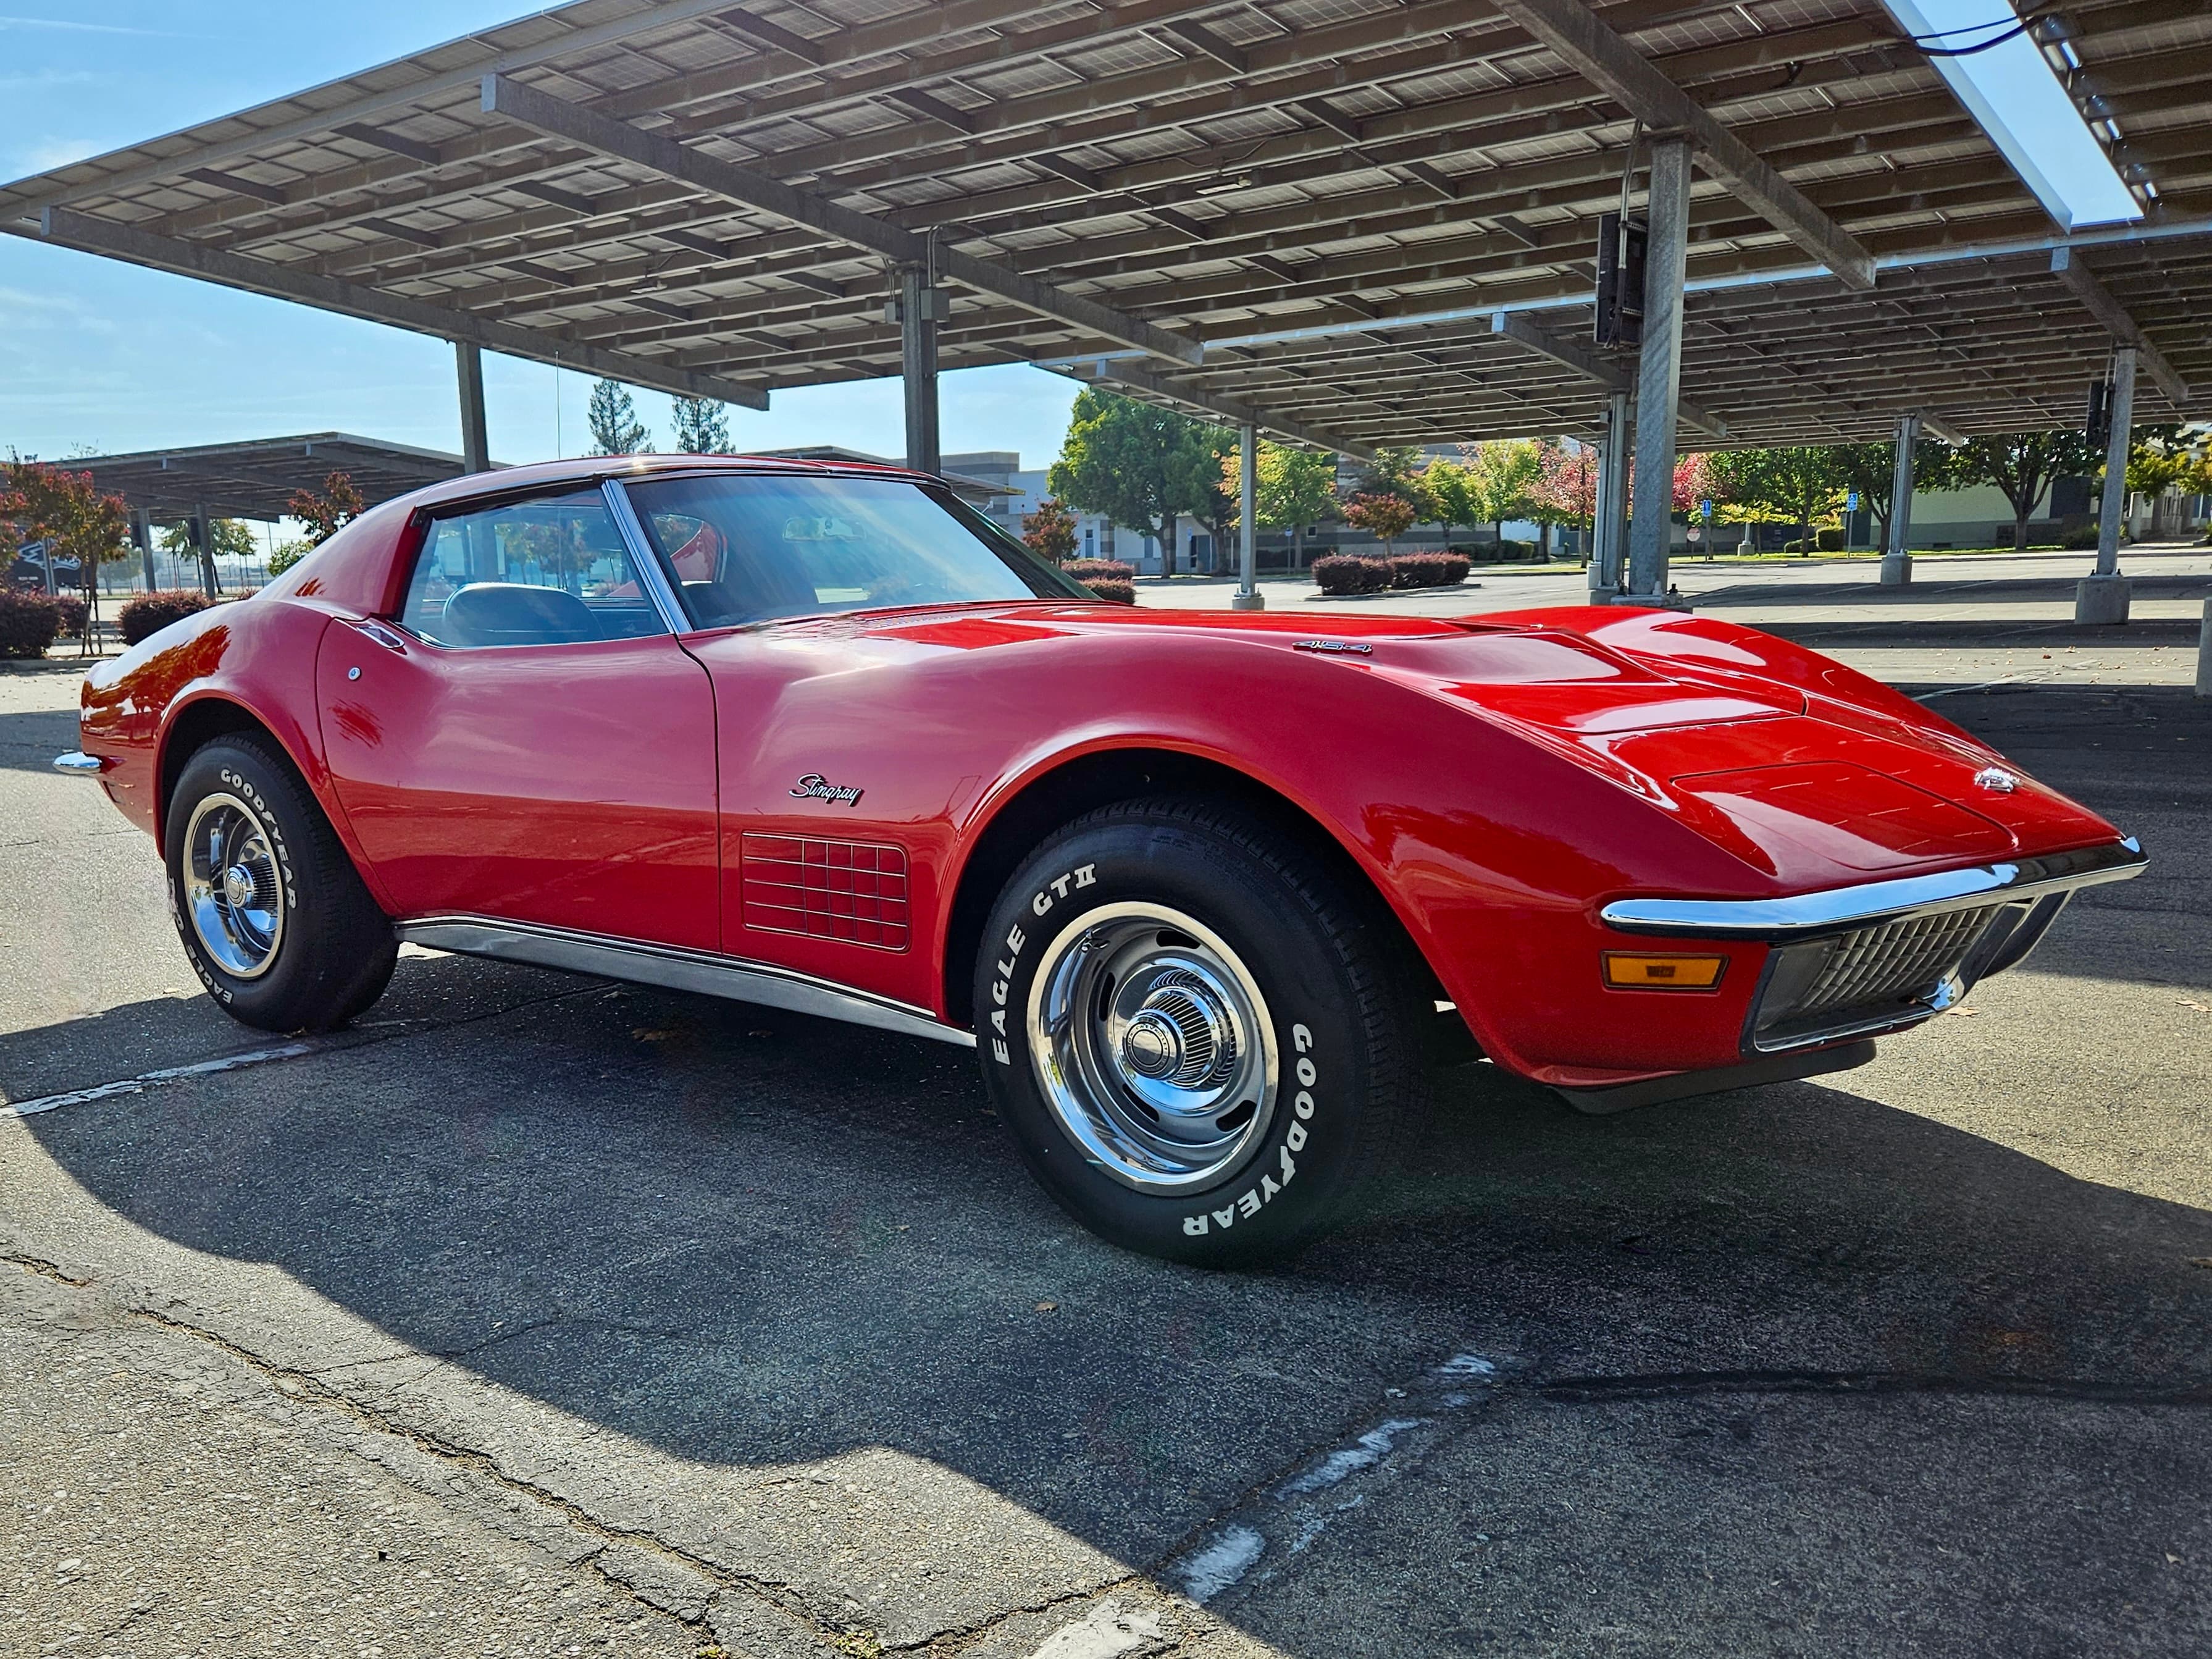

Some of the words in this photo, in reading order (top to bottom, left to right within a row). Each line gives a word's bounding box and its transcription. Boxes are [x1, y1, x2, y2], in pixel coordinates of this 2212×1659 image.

[1291, 640, 1373, 655] 454
[221, 768, 296, 909] GOODYEAR
[789, 773, 863, 807] Stingray
[186, 944, 233, 1003] EAGLE
[991, 924, 1026, 1065] EAGLE
[1182, 1023, 1317, 1236] GOODYEAR
